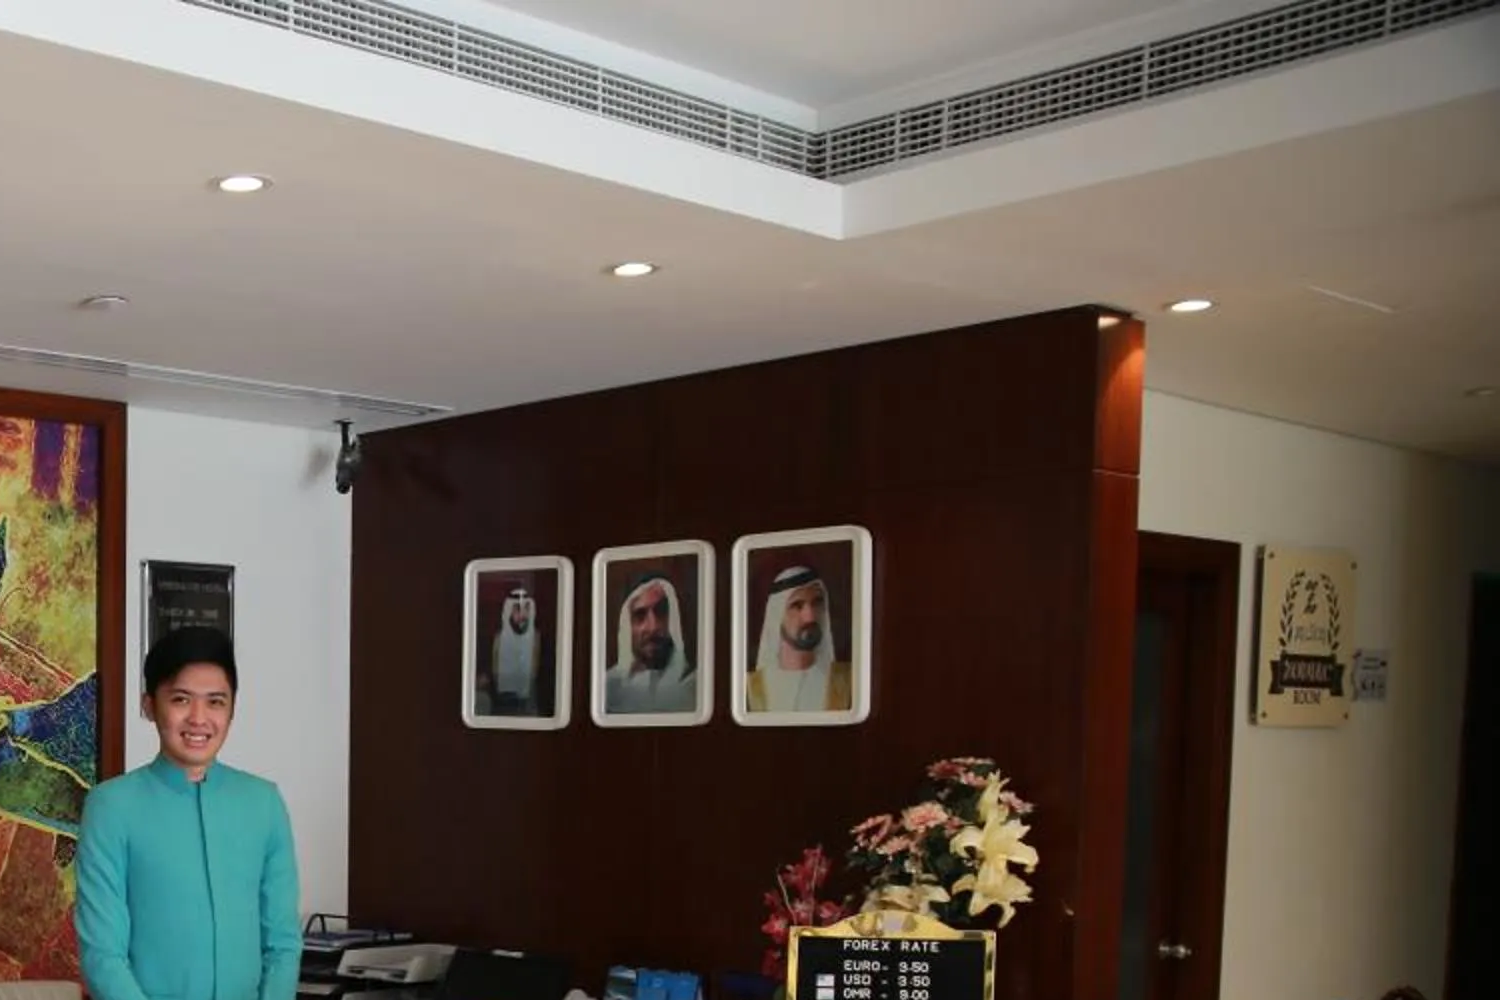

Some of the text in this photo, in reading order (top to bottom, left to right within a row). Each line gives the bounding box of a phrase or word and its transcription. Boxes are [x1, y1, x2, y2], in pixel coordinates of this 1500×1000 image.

[843, 939, 940, 953] FOREX RATE
[843, 959, 880, 972] EURO
[843, 973, 872, 985] USD
[843, 987, 872, 999] OMR
